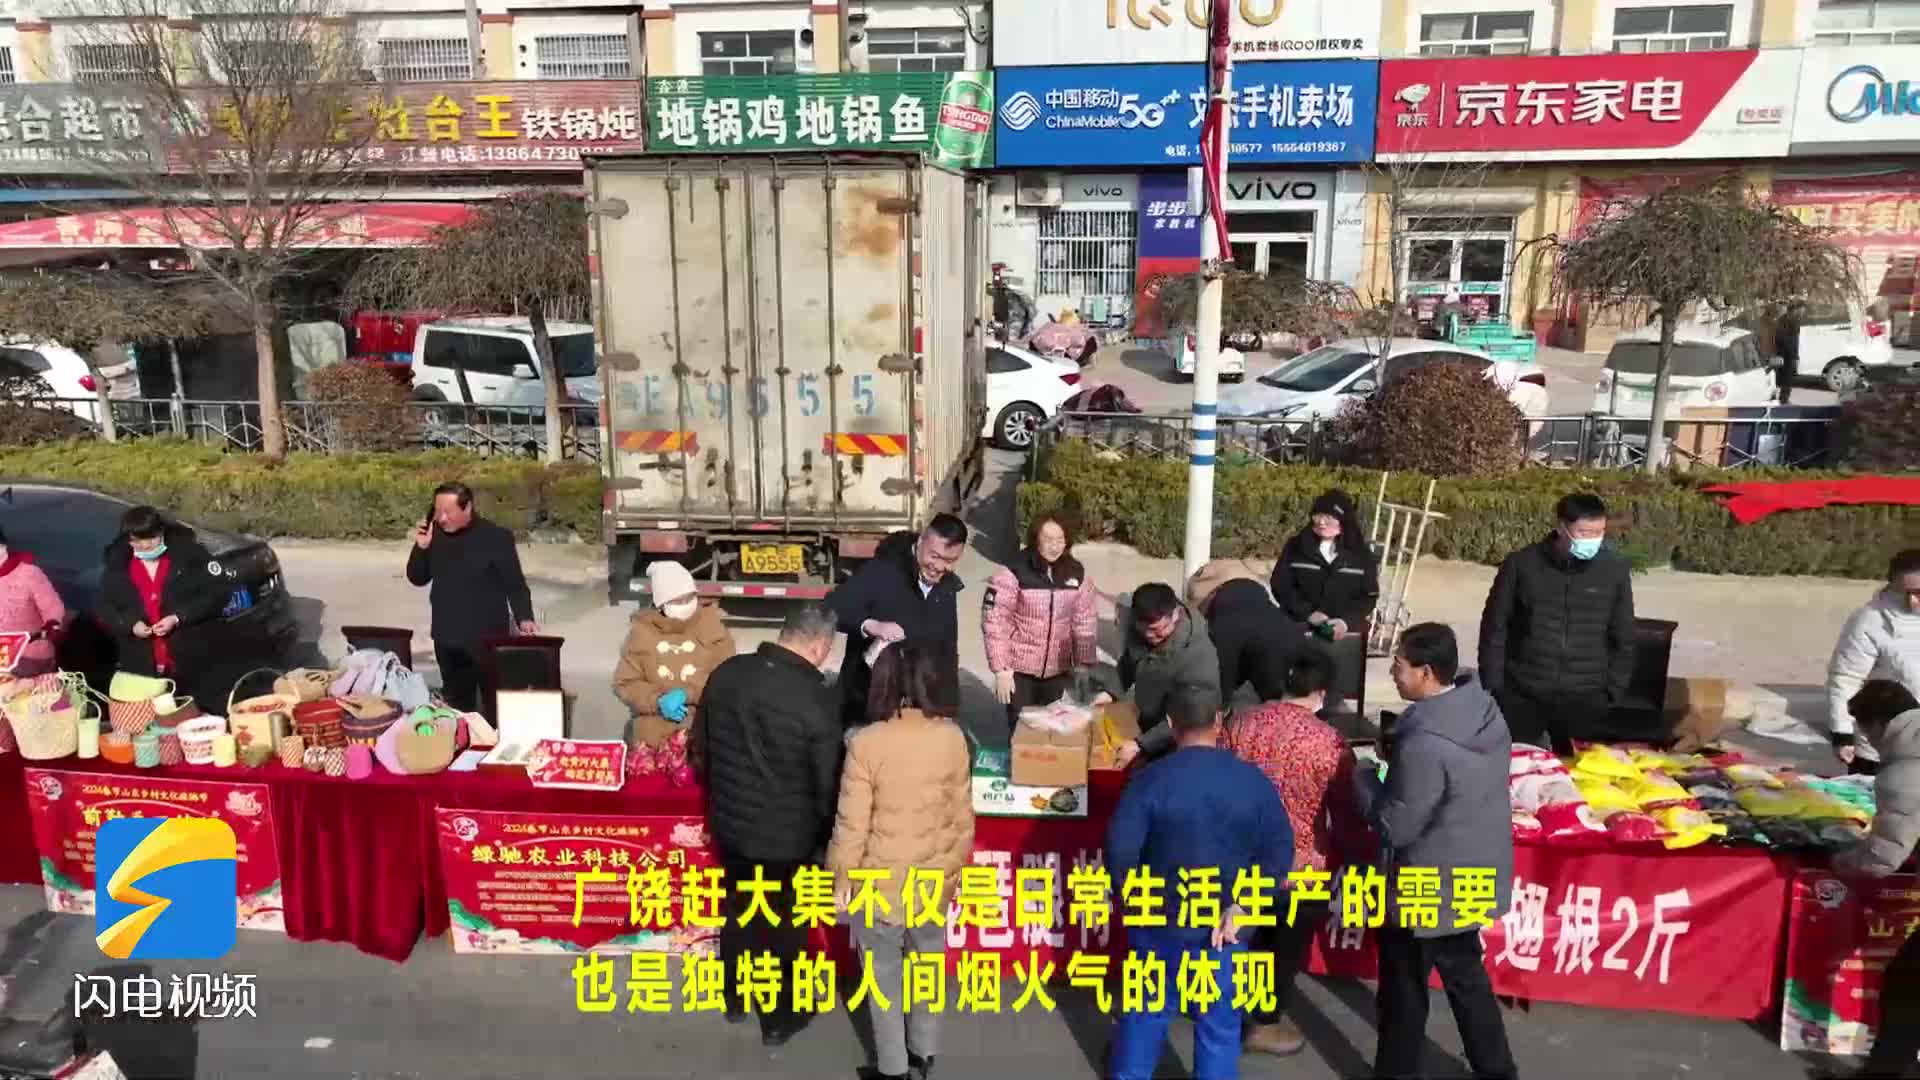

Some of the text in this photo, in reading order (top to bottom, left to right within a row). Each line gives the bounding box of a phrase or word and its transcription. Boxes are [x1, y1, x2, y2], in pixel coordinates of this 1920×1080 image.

[1046, 88, 1119, 110] 中国移动
[1456, 77, 1684, 126] 京东家电
[657, 94, 930, 147] 地锅鸡地锅鱼
[1046, 116, 1120, 130] ChinaMobile
[1396, 113, 1428, 128] 京东
[1083, 184, 1122, 197] vivo
[1227, 176, 1317, 201] vivo
[1146, 201, 1187, 217] 步步
[745, 555, 801, 573] A9555
[1480, 874, 1691, 984] 翅根2斤
